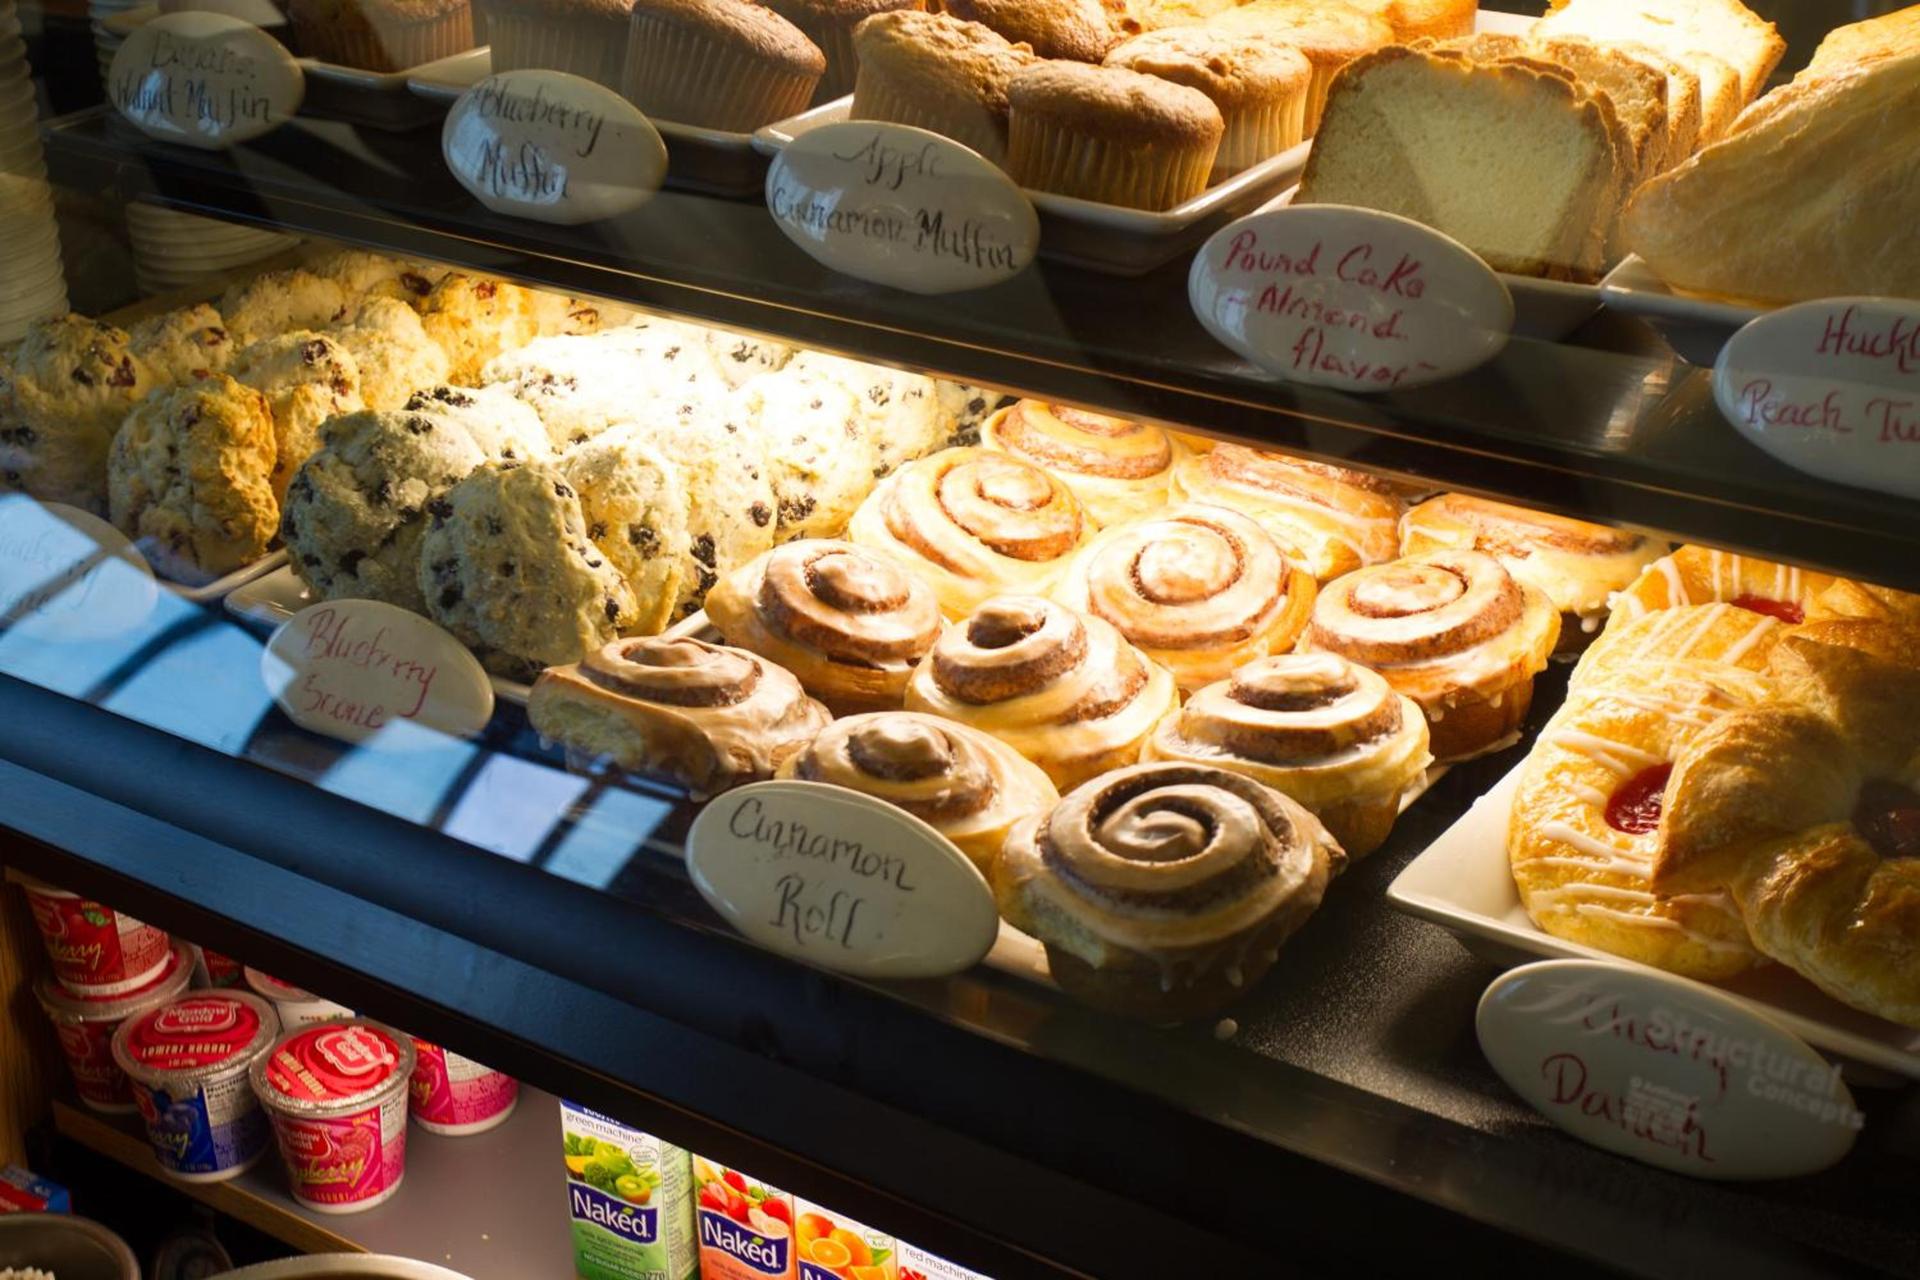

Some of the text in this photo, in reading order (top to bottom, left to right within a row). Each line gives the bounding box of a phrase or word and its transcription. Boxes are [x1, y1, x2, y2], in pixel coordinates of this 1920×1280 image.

[185, 79, 272, 128] Muffin
[474, 77, 604, 158] Blueberry
[477, 137, 569, 198] Muffin
[833, 131, 944, 190] Apple
[773, 187, 1017, 271] Cinnamon Muffin
[1223, 229, 1322, 276] Pound
[1741, 379, 1853, 433] Peach
[302, 673, 385, 729] Scone
[729, 797, 916, 892] Cinnamon
[769, 874, 865, 949] Roll
[566, 1112, 596, 1130] green
[596, 1121, 642, 1144] machine
[1747, 1073, 1866, 1131] Concepts
[572, 1188, 649, 1238] Naked
[703, 1215, 778, 1269] Naked
[904, 1247, 924, 1263] red
